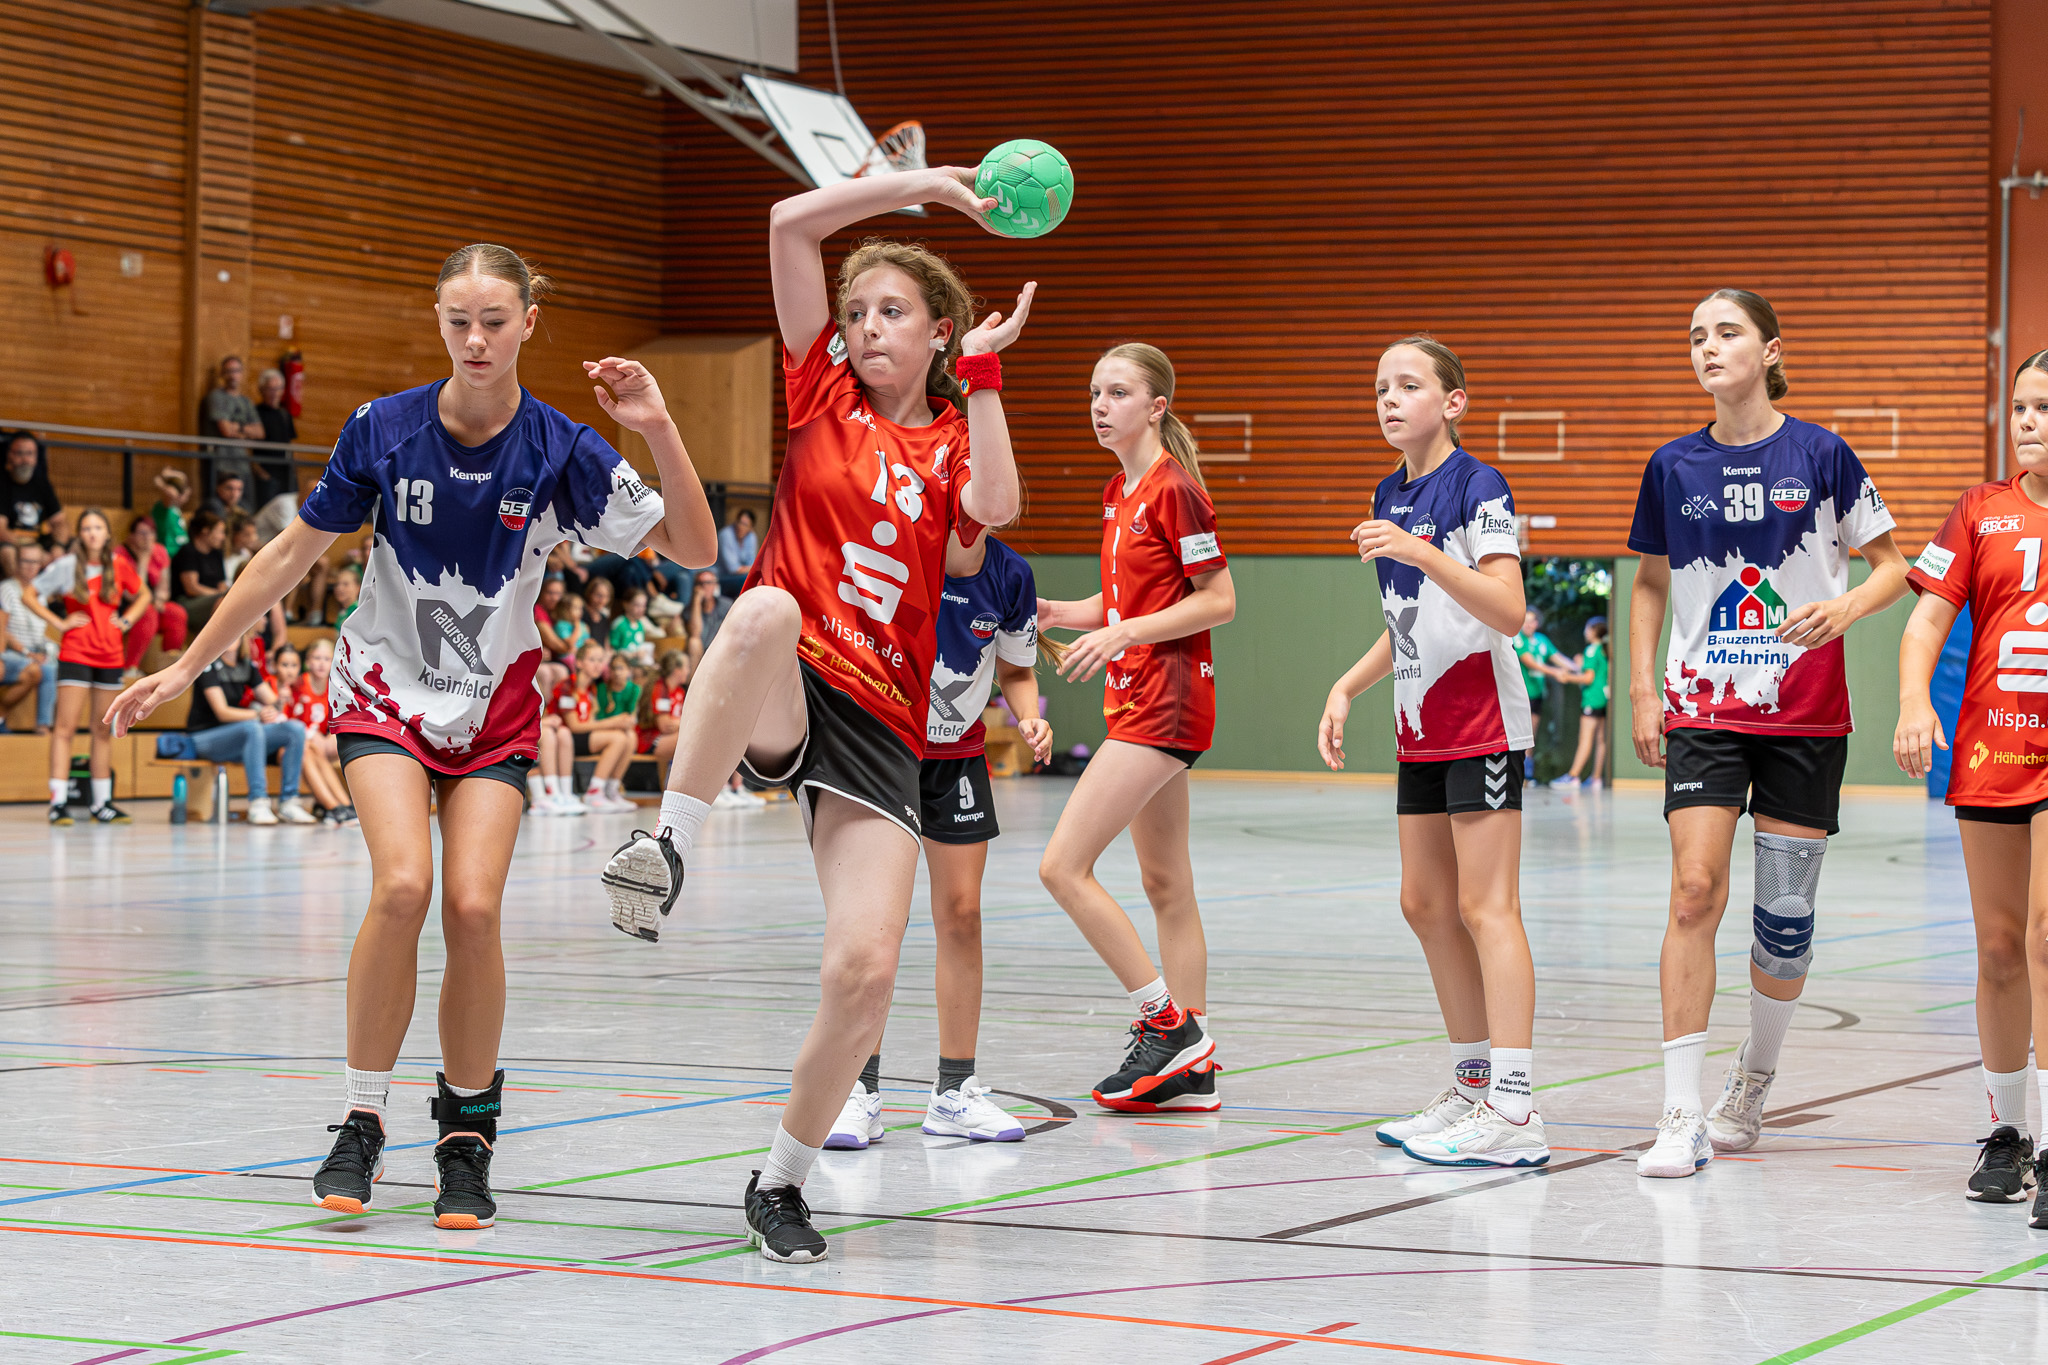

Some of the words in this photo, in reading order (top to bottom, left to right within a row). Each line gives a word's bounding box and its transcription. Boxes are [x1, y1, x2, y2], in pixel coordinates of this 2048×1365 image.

[450, 467, 491, 484] Kempa
[1723, 466, 1761, 477] Kempa
[871, 451, 925, 523] 13
[1771, 490, 1807, 499] HSG
[395, 478, 434, 525] 13
[1723, 483, 1764, 522] 39
[1980, 519, 2020, 533] BECK
[1920, 556, 1946, 575] rewing
[2013, 538, 2042, 591] 1
[941, 591, 969, 604] Kempa
[430, 606, 479, 668] natursteine
[822, 614, 903, 668] Nispa.de
[1707, 635, 1784, 646] Bauzentru
[1706, 649, 1789, 669] Mehring
[418, 666, 492, 699] Kleinfeld
[1988, 708, 2048, 731] Nispa.
[928, 724, 964, 736] nfeld
[958, 776, 975, 810] 9
[1673, 782, 1703, 792] Kempa
[954, 812, 984, 823] Kempa
[460, 1102, 500, 1114] AIRCAS
